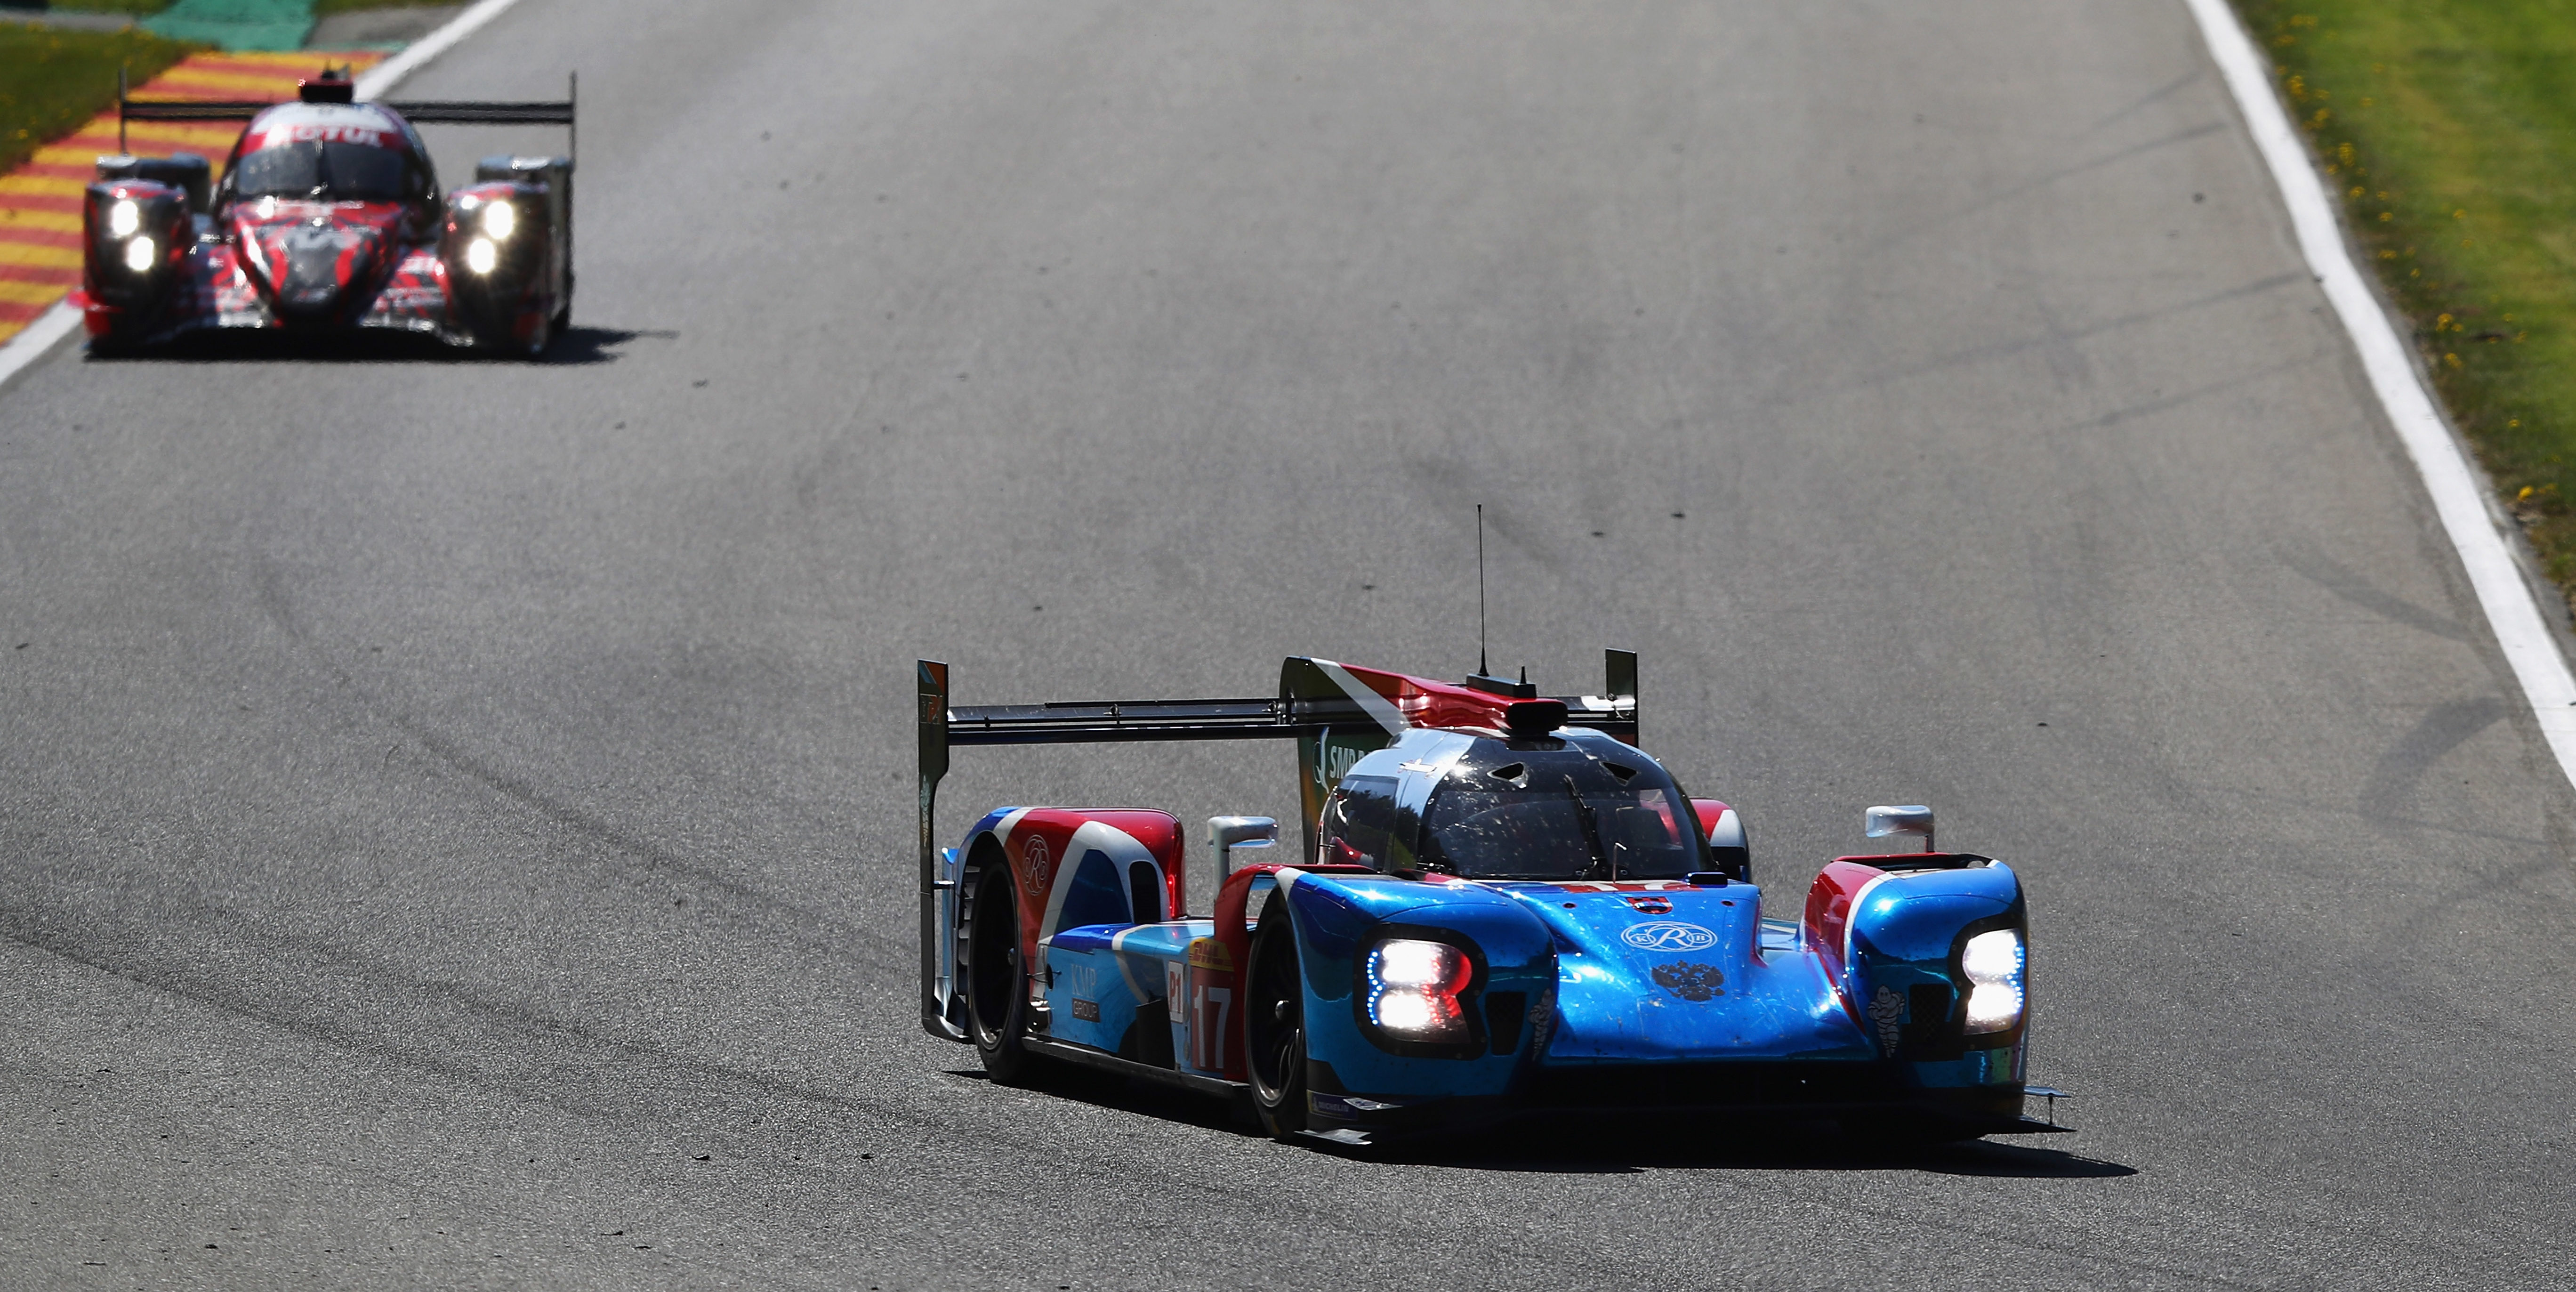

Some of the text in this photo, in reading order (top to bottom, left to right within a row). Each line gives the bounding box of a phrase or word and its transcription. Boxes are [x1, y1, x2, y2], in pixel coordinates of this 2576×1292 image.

[1329, 745, 1356, 778] SMP
[1193, 942, 1224, 965] DHL
[1169, 971, 1181, 1014] P1
[1073, 1001, 1098, 1018] GROUP
[1194, 985, 1231, 1068] 17
